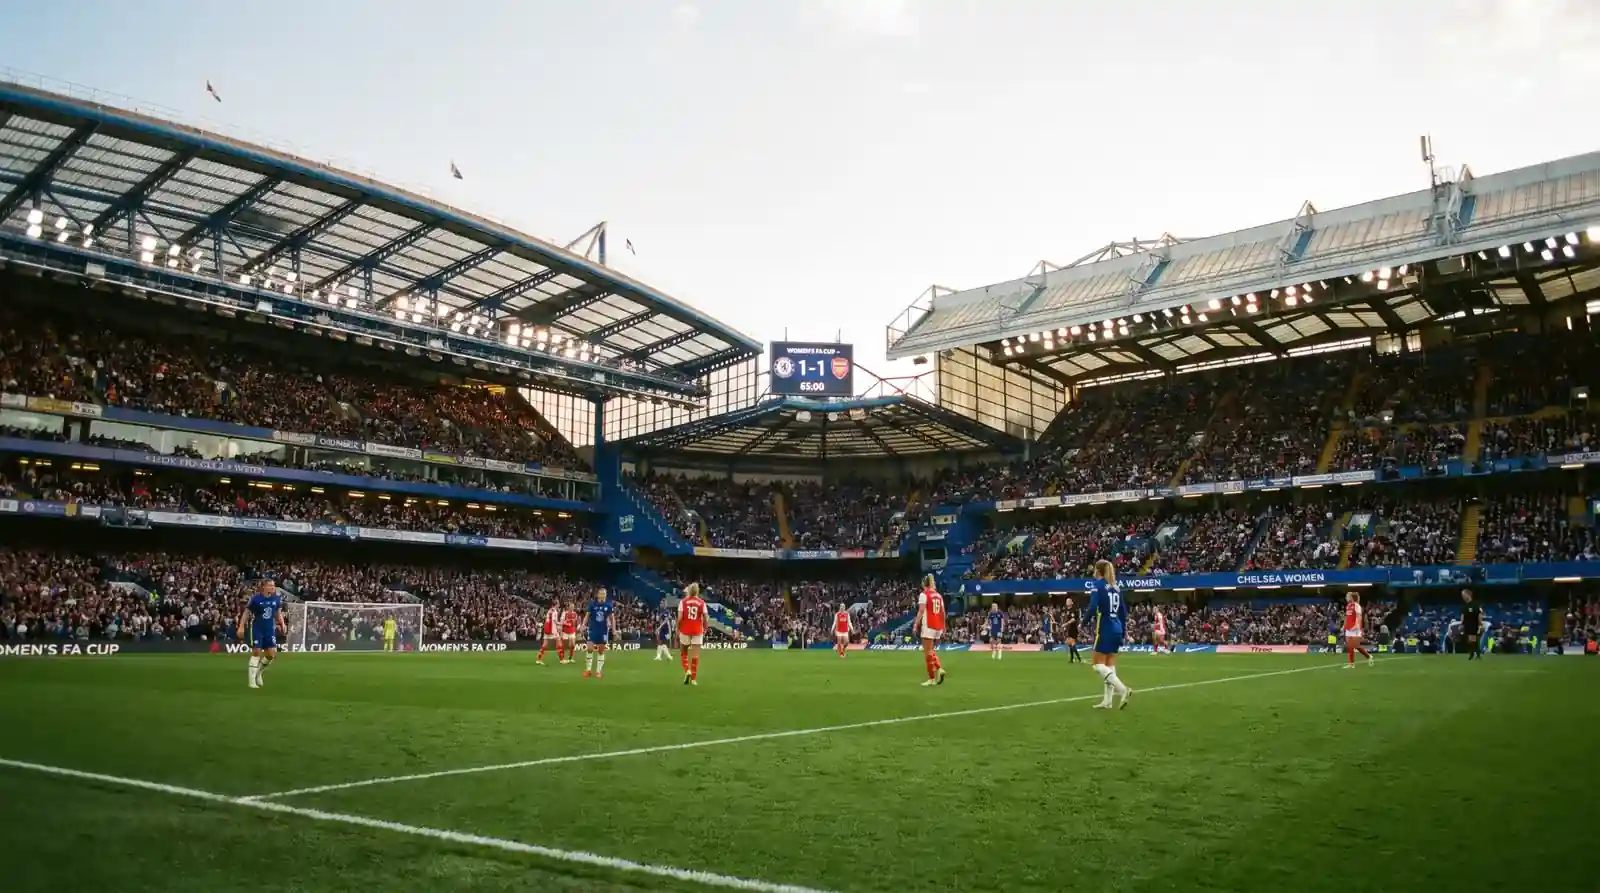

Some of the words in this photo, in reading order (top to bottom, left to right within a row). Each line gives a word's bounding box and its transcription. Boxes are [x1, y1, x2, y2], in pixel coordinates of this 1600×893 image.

[798, 359, 825, 377] 1-1
[1126, 579, 1161, 588] WOMEN
[1237, 574, 1282, 585] CHELSEA
[1283, 573, 1325, 583] WOMEN
[1108, 592, 1120, 613] 19
[687, 606, 698, 620] 19
[62, 643, 82, 655] FA
[87, 643, 119, 655] CUP
[226, 643, 289, 653] WO'S
[292, 643, 306, 653] FA
[310, 643, 336, 653] CUP
[420, 643, 469, 652] WOMEN'S
[472, 643, 484, 652] FA
[486, 643, 507, 652] CUP
[612, 643, 622, 651] FA
[624, 642, 641, 650] CUP
